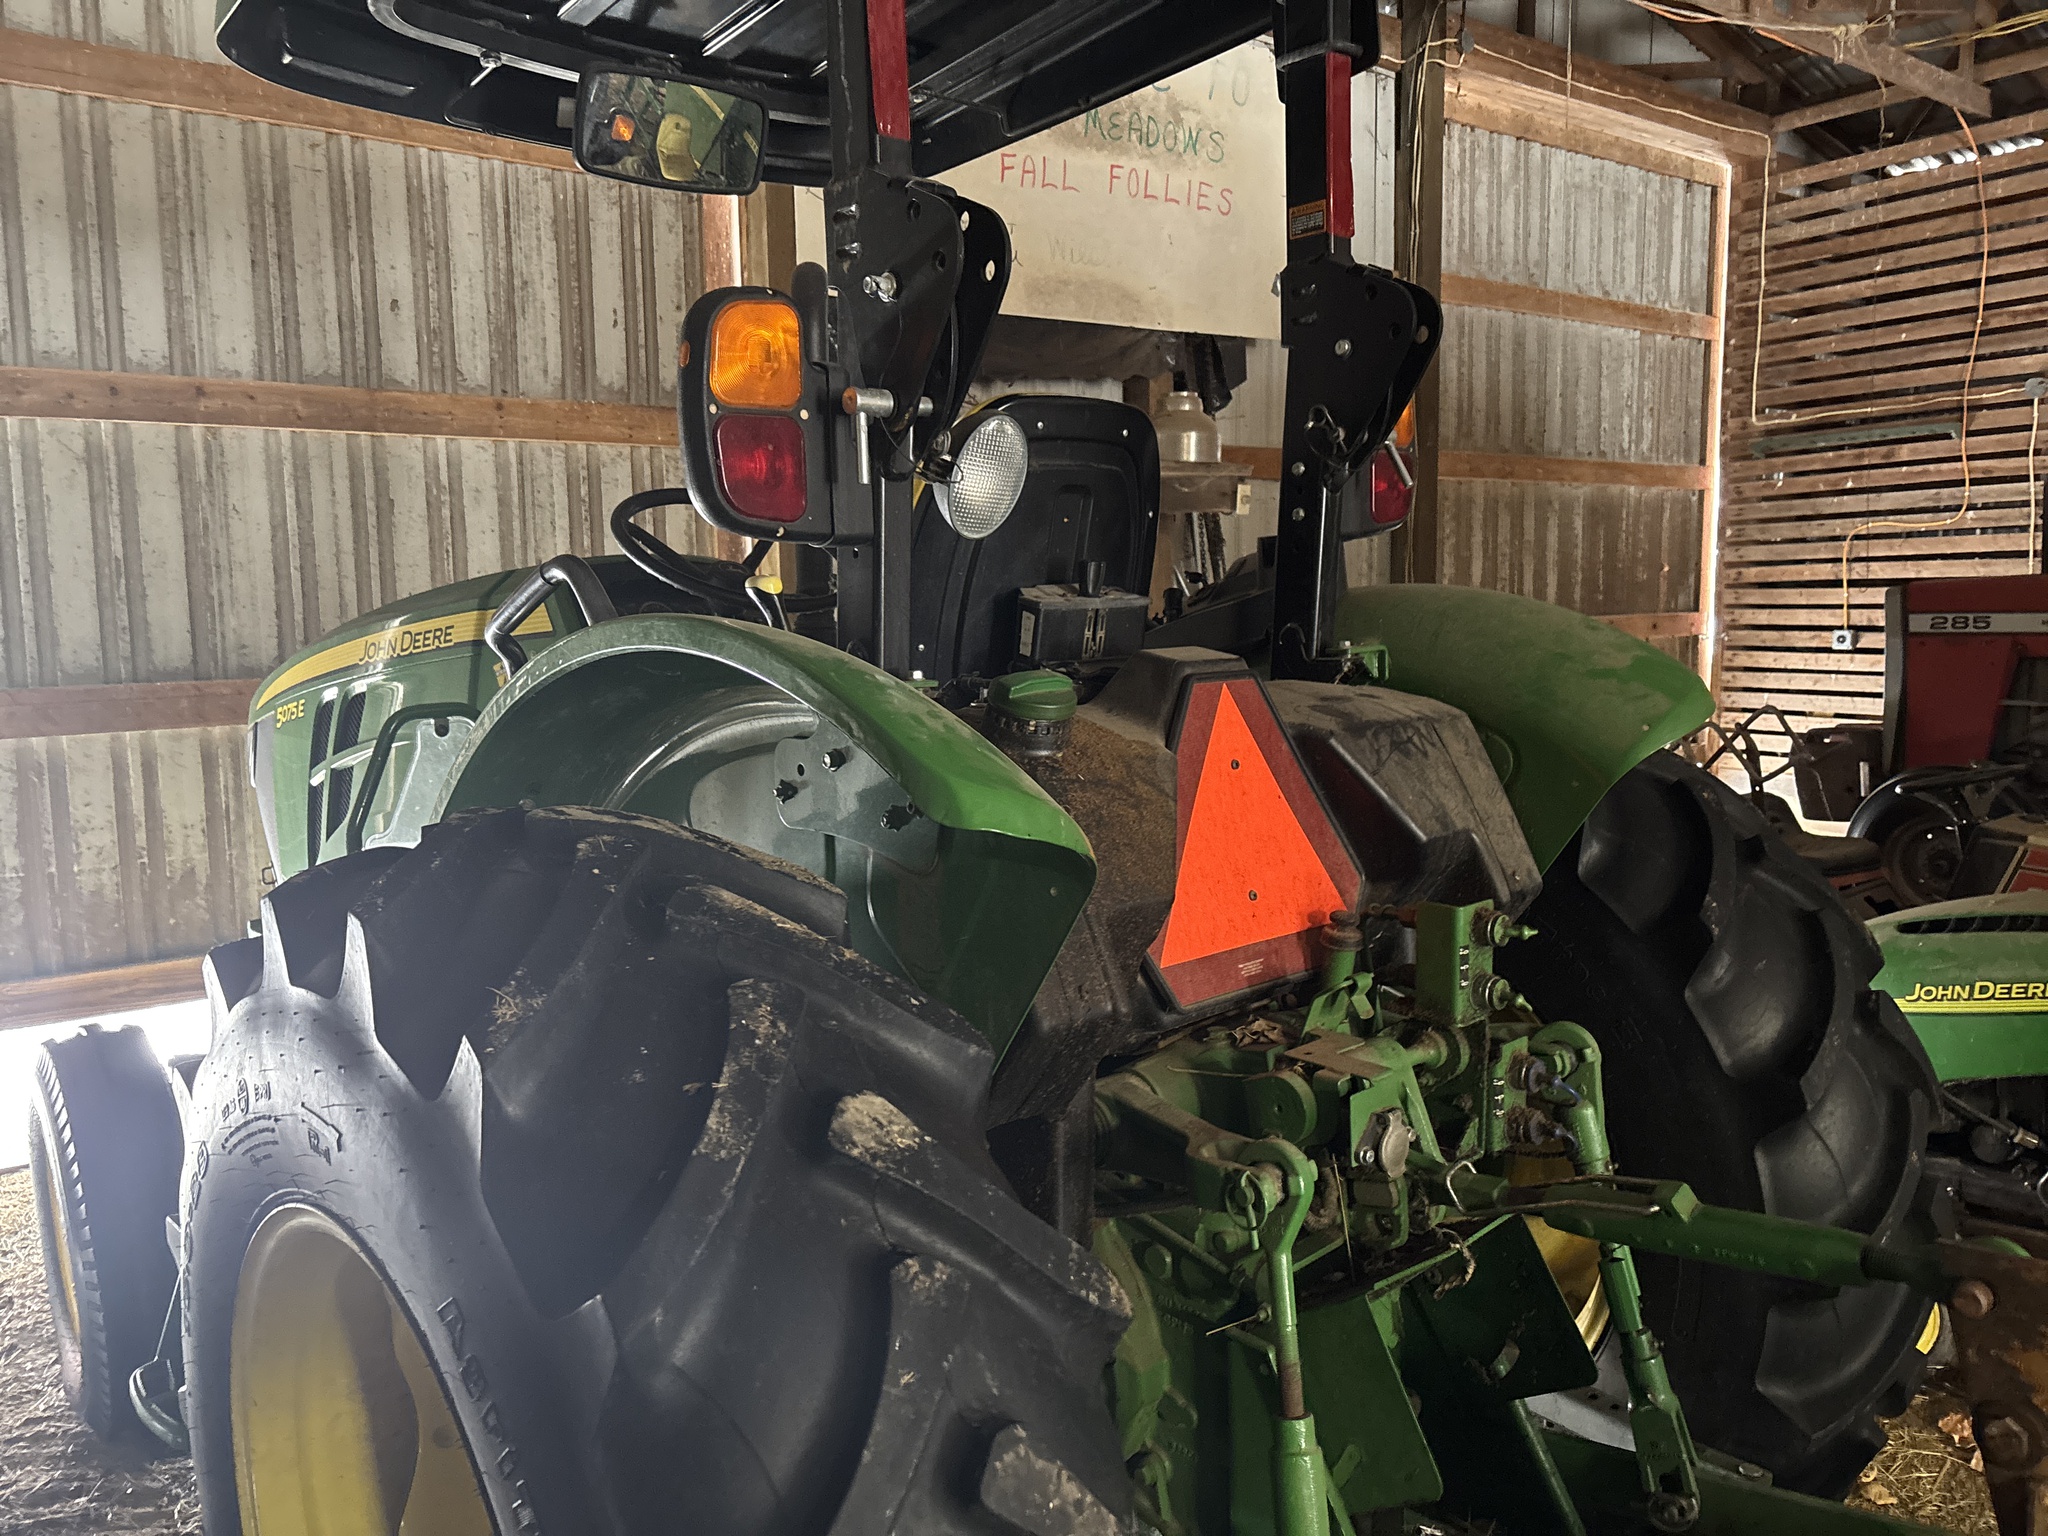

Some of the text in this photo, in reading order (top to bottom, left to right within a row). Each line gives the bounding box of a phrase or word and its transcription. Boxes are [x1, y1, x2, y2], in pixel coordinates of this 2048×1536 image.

[1084, 108, 1226, 164] MEADOWS
[1000, 153, 1234, 217] FALL FOLLIES
[1929, 615, 1992, 631] 285
[358, 624, 456, 662] JOHN DEERE
[1904, 980, 2048, 1002] JOHN DEER
